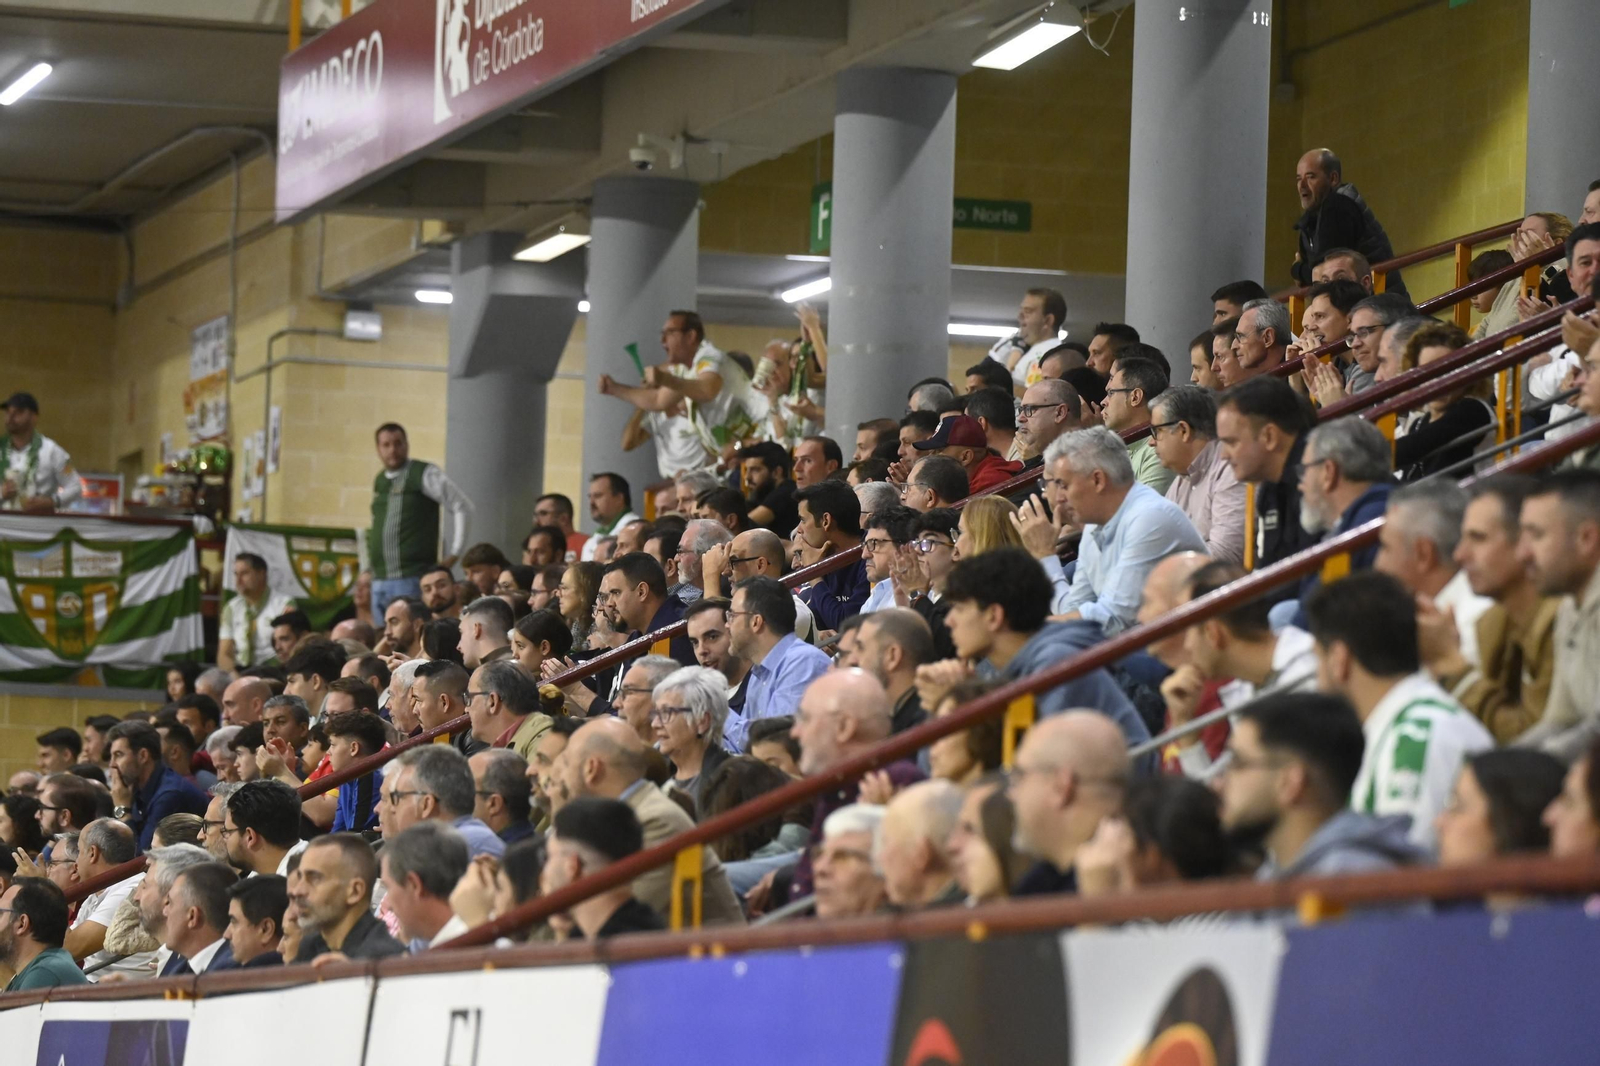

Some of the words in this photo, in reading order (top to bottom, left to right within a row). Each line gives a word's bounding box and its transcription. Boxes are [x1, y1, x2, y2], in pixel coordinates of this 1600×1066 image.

[473, 40, 490, 85] de
[492, 12, 544, 74] Córdoba
[972, 206, 1019, 225] Norte
